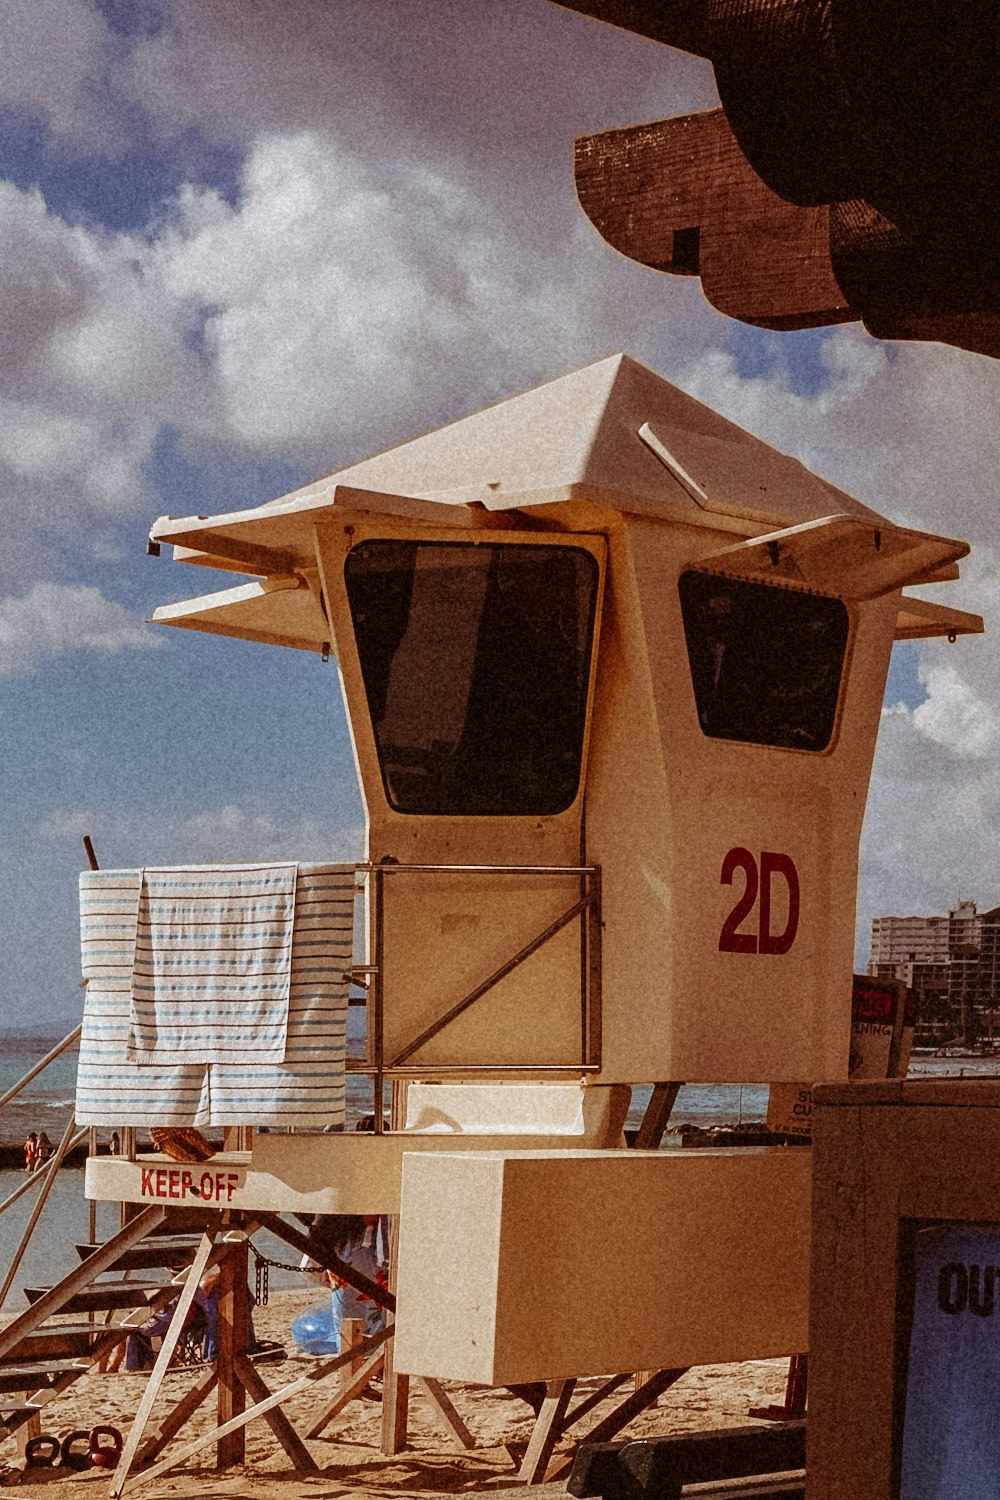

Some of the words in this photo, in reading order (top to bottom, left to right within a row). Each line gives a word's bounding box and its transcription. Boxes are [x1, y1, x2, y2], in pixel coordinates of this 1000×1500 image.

[717, 846, 800, 956] 2D
[141, 1168, 193, 1199] KEEP
[200, 1171, 239, 1202] OFF
